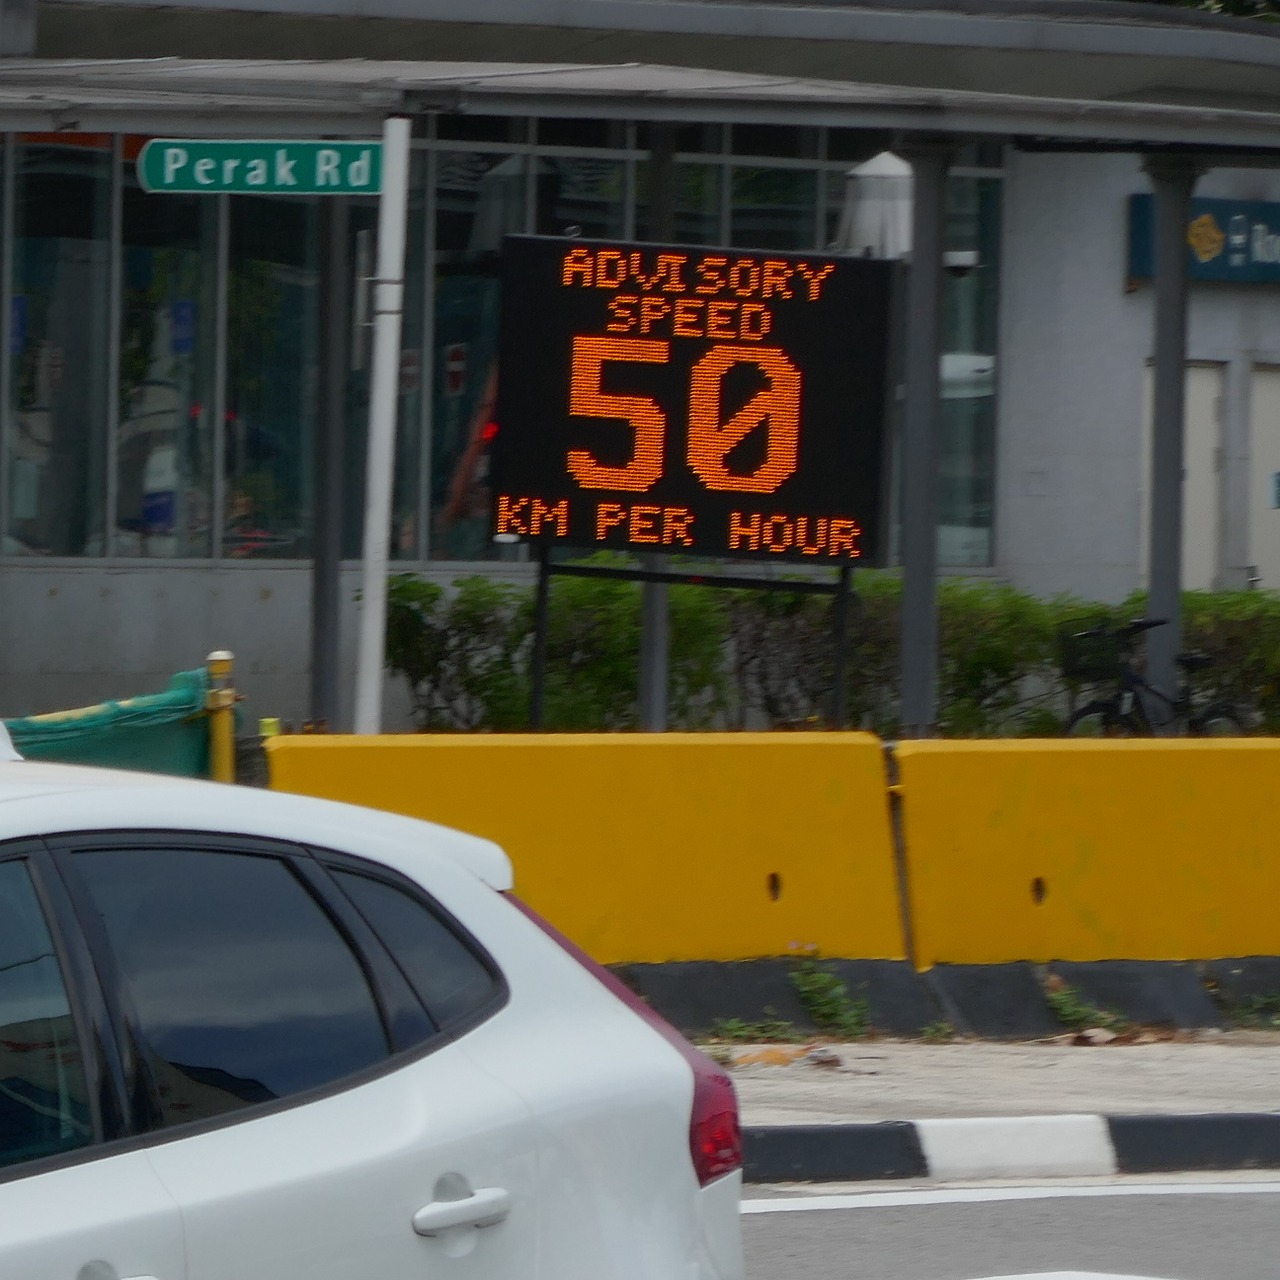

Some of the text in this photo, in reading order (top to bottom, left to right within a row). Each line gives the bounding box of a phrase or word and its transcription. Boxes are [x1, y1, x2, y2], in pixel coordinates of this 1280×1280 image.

[163, 148, 372, 187] Perak Rd
[562, 249, 835, 300] ADVISORY
[606, 296, 771, 340] SPEED
[566, 335, 803, 493] 50
[497, 496, 862, 558] KM PER HOUR
